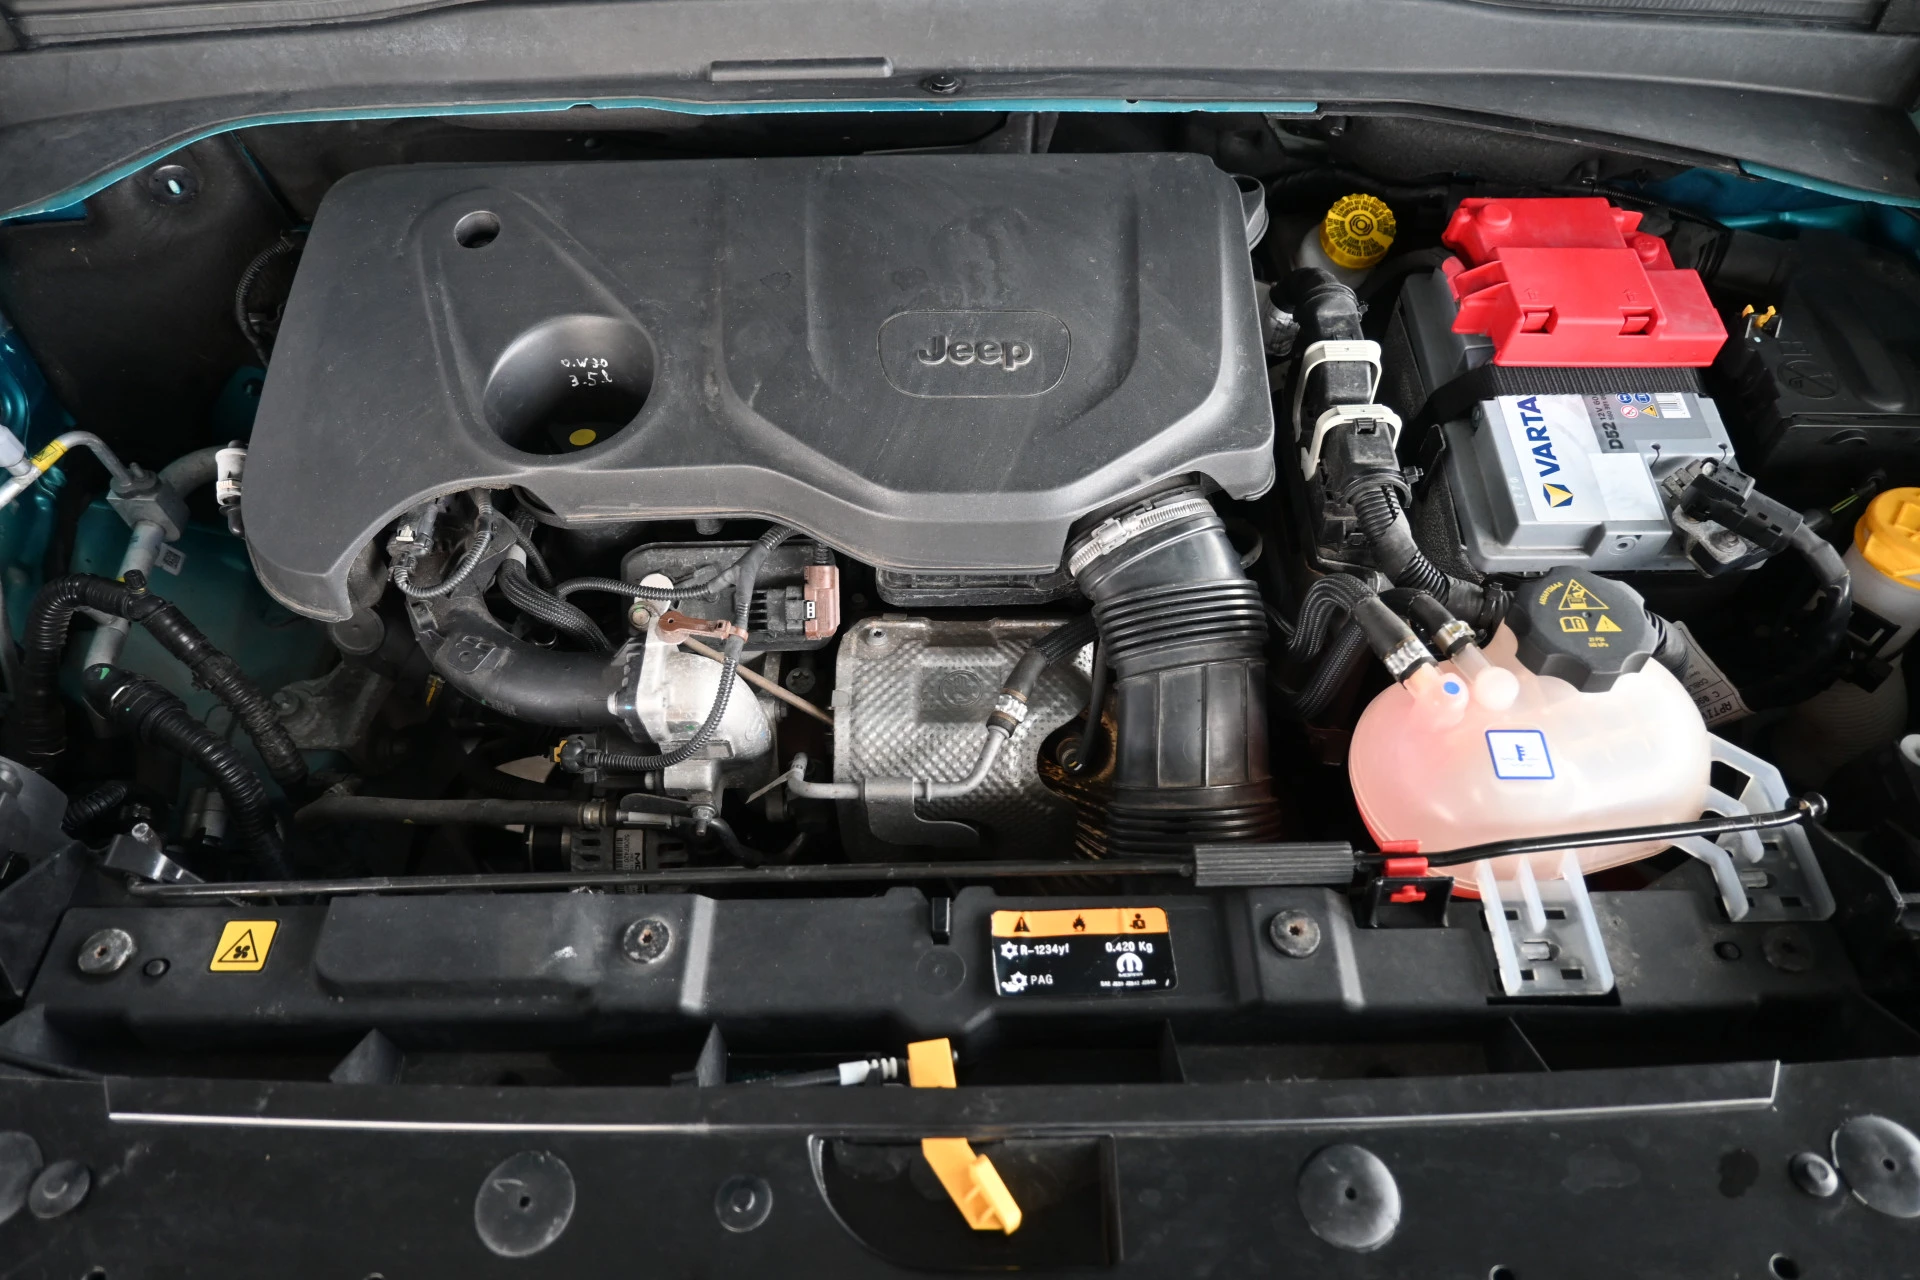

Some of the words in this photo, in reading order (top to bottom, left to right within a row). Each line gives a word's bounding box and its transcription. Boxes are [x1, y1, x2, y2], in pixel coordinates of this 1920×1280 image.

[918, 335, 1032, 371] Jeep
[1597, 408, 1606, 420] 12V
[1517, 396, 1560, 477] VARTA
[1602, 421, 1624, 449] D52
[1020, 943, 1069, 956] R-1234yf
[1105, 941, 1135, 953] 0.420
[1138, 941, 1153, 953] Kg
[1030, 974, 1053, 985] PAG
